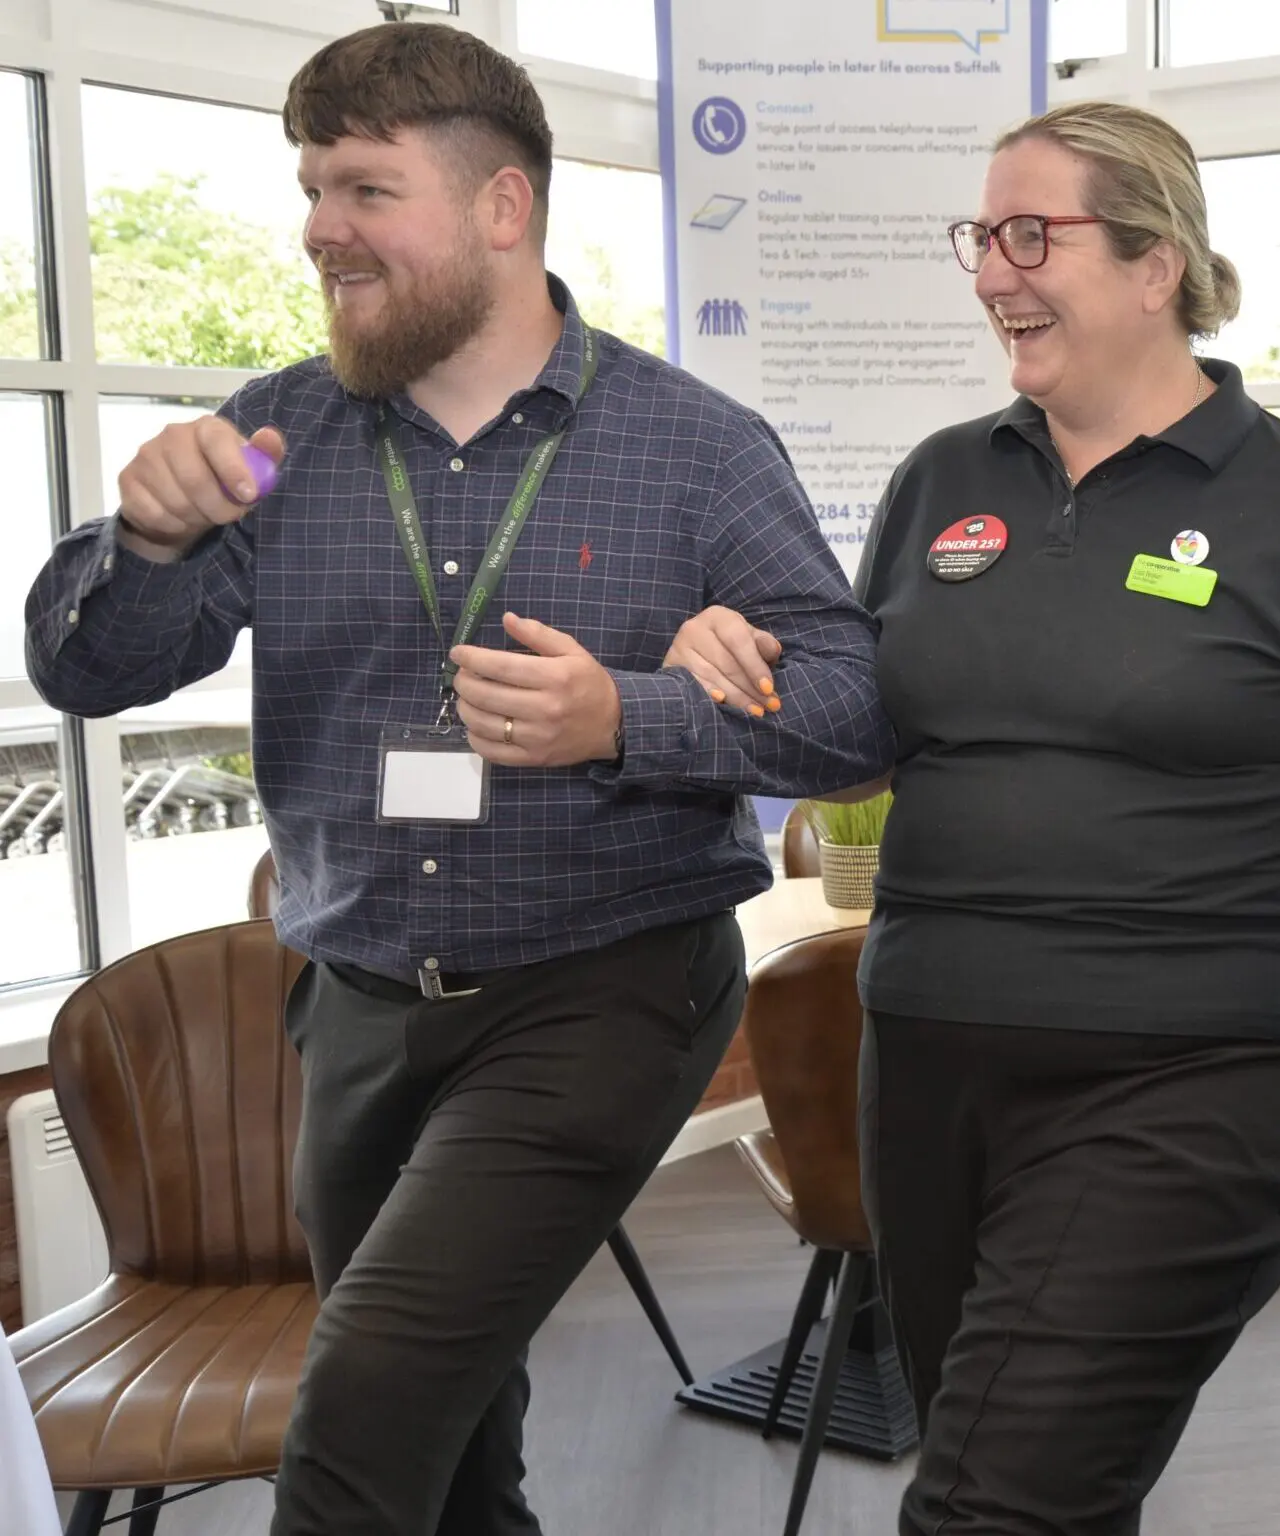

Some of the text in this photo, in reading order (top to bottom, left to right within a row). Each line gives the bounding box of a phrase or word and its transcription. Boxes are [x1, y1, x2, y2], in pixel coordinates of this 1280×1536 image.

[698, 59, 1001, 75] Supporting people in later life across Suffolk
[756, 101, 814, 113] Connect
[756, 122, 978, 137] Single point of access telephone support
[797, 141, 813, 152] for
[816, 142, 848, 152] issues
[850, 144, 862, 152] or
[865, 143, 913, 153] concerns
[917, 141, 967, 155] affecting
[769, 160, 797, 171] later
[799, 160, 815, 171] life
[758, 190, 802, 203] Online
[758, 211, 799, 225] Regular
[803, 211, 834, 222] tablet
[838, 212, 880, 225] training
[883, 214, 923, 222] courses
[926, 213, 938, 222] to
[758, 232, 797, 244] people
[800, 232, 811, 242] to
[815, 231, 857, 242] become
[861, 234, 887, 242] more
[759, 250, 779, 260] Tea
[782, 250, 791, 260] &
[794, 250, 819, 260] Tech
[830, 250, 888, 263] community
[892, 250, 925, 260] based
[759, 268, 775, 278] for
[778, 269, 815, 281] people
[818, 268, 847, 281] aged
[760, 299, 811, 314] Engage
[760, 320, 804, 333] Working
[806, 320, 829, 330] with
[832, 320, 887, 330] individuals
[903, 320, 928, 330] their
[930, 320, 988, 333] community
[761, 339, 975, 351] encourage community engagement and
[827, 357, 860, 367] Social
[863, 359, 894, 370] group
[898, 359, 965, 370] engagement
[762, 375, 804, 387] through
[862, 375, 883, 386] and
[886, 375, 946, 387] Community
[763, 394, 797, 404] events
[384, 437, 399, 465] central
[830, 441, 892, 454] befriending
[824, 480, 844, 490] and
[847, 480, 865, 489] out
[868, 480, 881, 489] of
[401, 507, 412, 525] We
[488, 553, 501, 568] We
[498, 537, 508, 551] are
[504, 519, 516, 535] the
[512, 471, 538, 518] difference
[406, 526, 415, 541] are
[936, 538, 1002, 550] UNDER 25?
[411, 543, 420, 560] the
